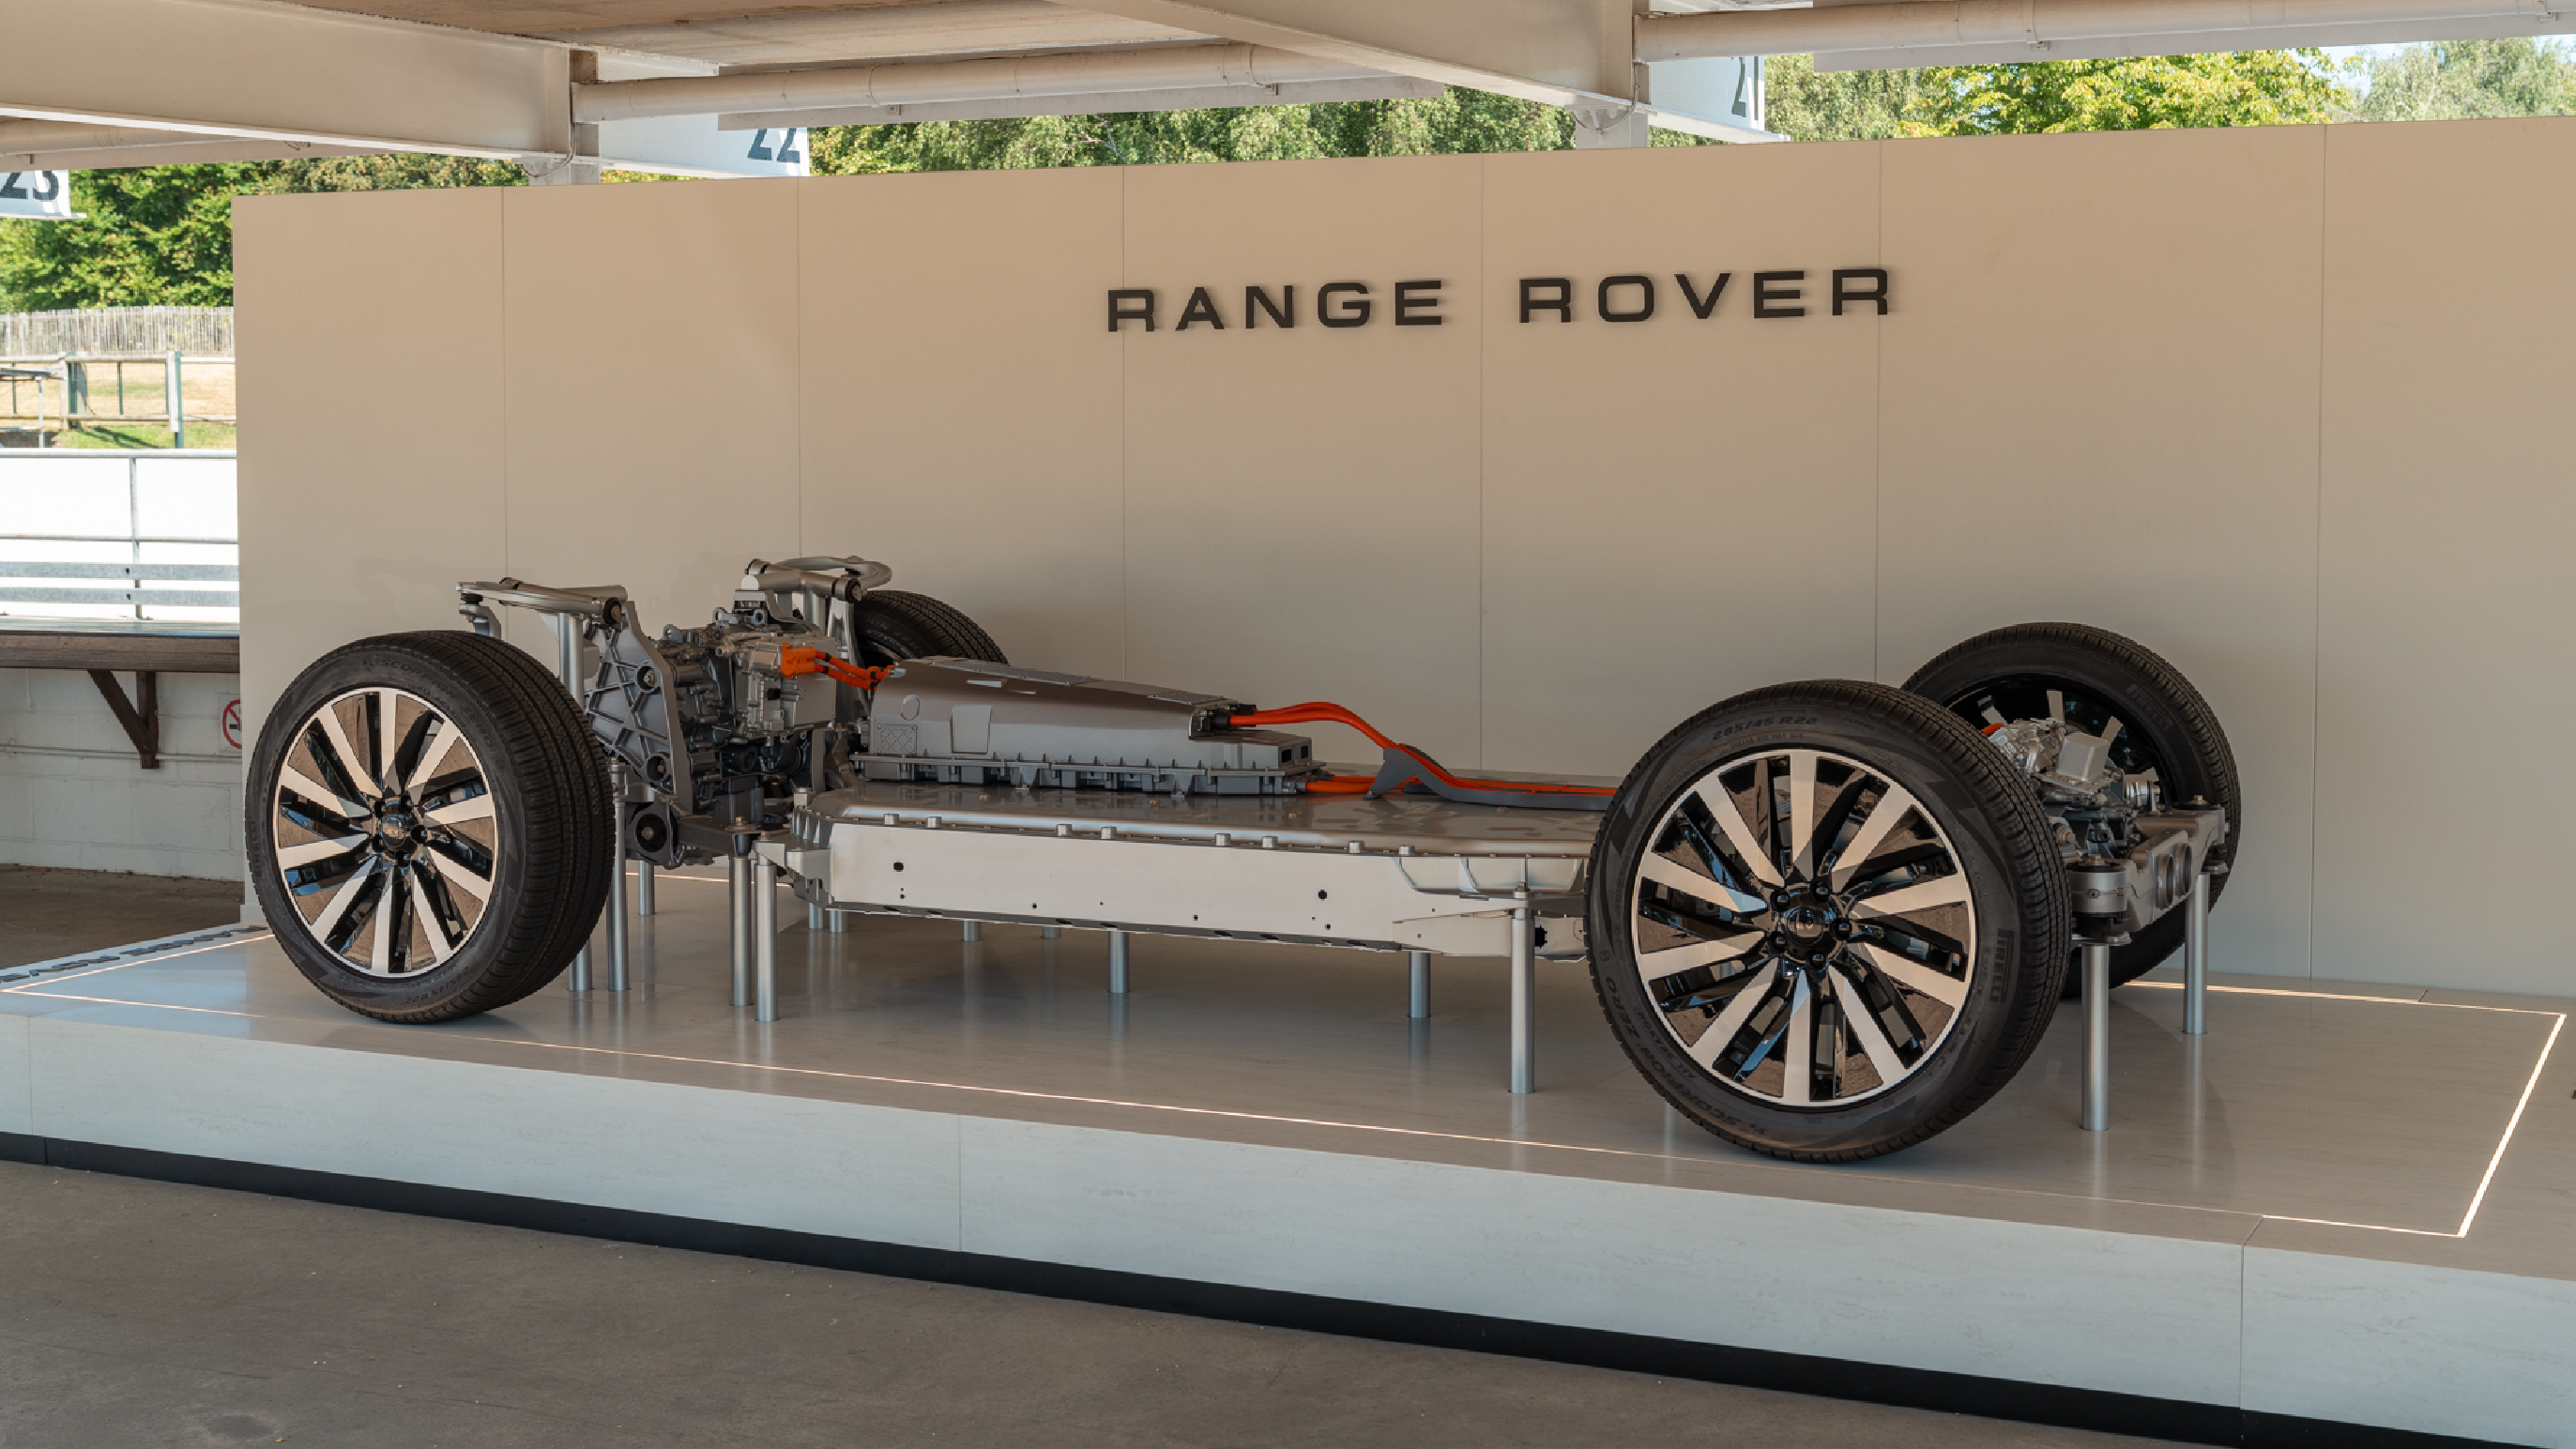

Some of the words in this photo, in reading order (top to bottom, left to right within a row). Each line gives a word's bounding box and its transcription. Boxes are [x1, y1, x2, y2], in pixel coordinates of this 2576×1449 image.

[1107, 280, 1442, 332] RANGE
[1518, 268, 1888, 323] ROVER
[1989, 927, 2016, 1004] PIRELLI
[1605, 975, 1642, 1040] ZERO
[1639, 1045, 1742, 1127] SCORPION
